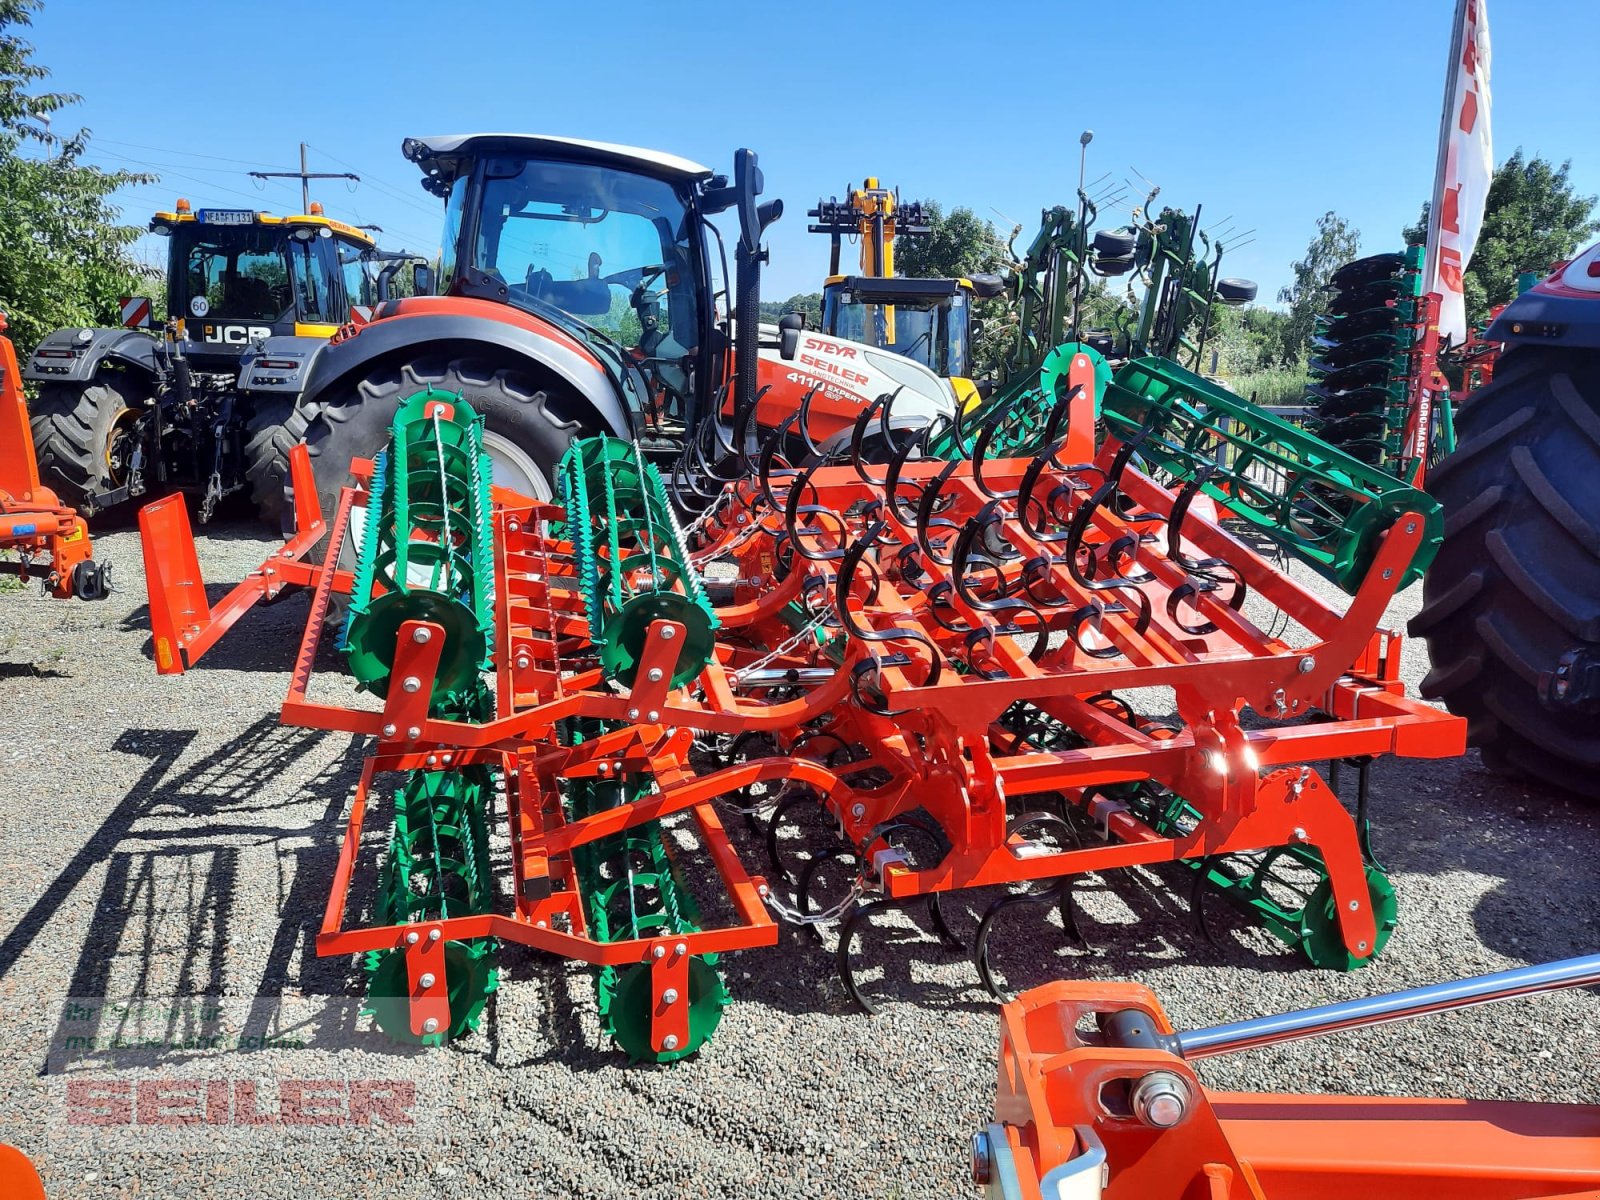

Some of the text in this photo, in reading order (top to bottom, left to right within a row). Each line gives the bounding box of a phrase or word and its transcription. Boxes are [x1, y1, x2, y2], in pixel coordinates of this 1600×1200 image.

[237, 212, 252, 223] 131
[193, 301, 207, 311] 60
[804, 338, 857, 360] STEYR
[800, 353, 870, 386] SEILER
[808, 368, 856, 390] LANDTECHNIK
[786, 372, 863, 404] 4110 EXPERT
[1416, 396, 1430, 454] AGRO-MASZ
